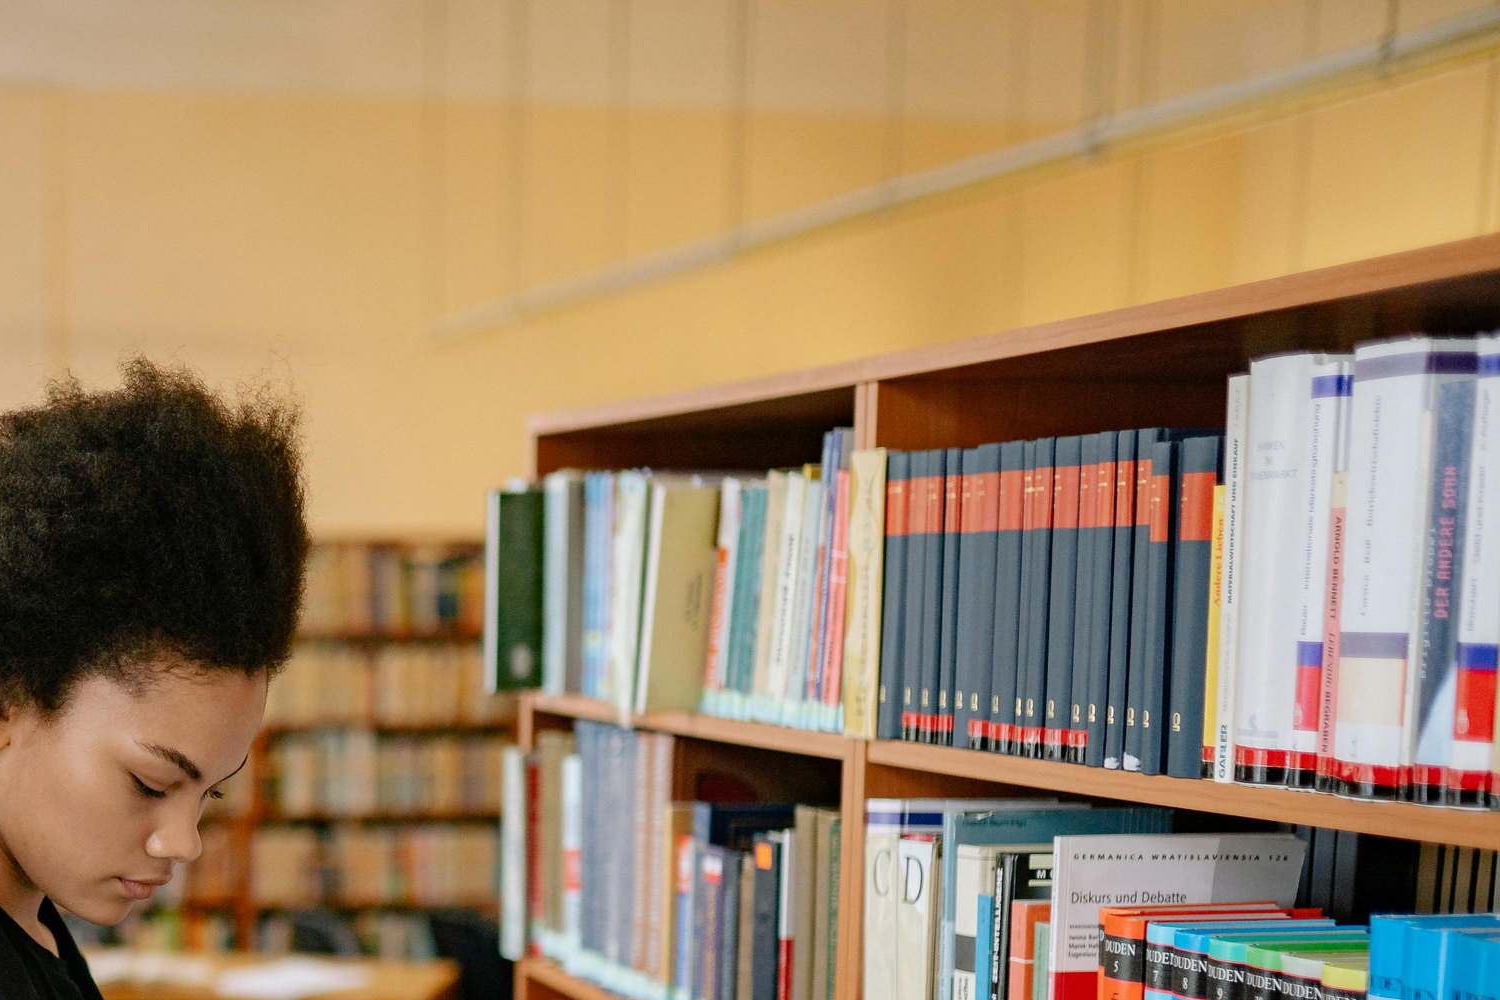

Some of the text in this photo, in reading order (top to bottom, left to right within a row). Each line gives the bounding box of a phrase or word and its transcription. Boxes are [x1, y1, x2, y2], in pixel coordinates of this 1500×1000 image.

[1301, 403, 1322, 636] Bauer Internationale Marketingforschung
[1475, 509, 1484, 532] und
[1433, 465, 1458, 619] DER ANDERE SOHN
[1213, 517, 1225, 608] Andere Lieben
[1218, 724, 1228, 779] GABLER
[1227, 503, 1237, 604] MATERIALWIRTSCHAFT
[1321, 516, 1343, 754] ARNOLD BENNETT LEBENDIG BEGRABEN
[1073, 853, 1289, 861] GERMANICA WRATISLAVIENSIA 126
[873, 849, 892, 898] C
[903, 855, 924, 905] D
[1071, 890, 1187, 904] Diskurs und Debatte
[1105, 937, 1136, 956] DUDEN
[1113, 961, 1119, 973] 5
[1173, 951, 1208, 973] DUDEN
[1153, 970, 1159, 982] 7
[1182, 977, 1189, 989] 8
[1208, 964, 1245, 984] DUDEN
[1246, 972, 1282, 992] DUDEN
[1216, 987, 1223, 999] 9
[1282, 981, 1323, 1000] DUDEN
